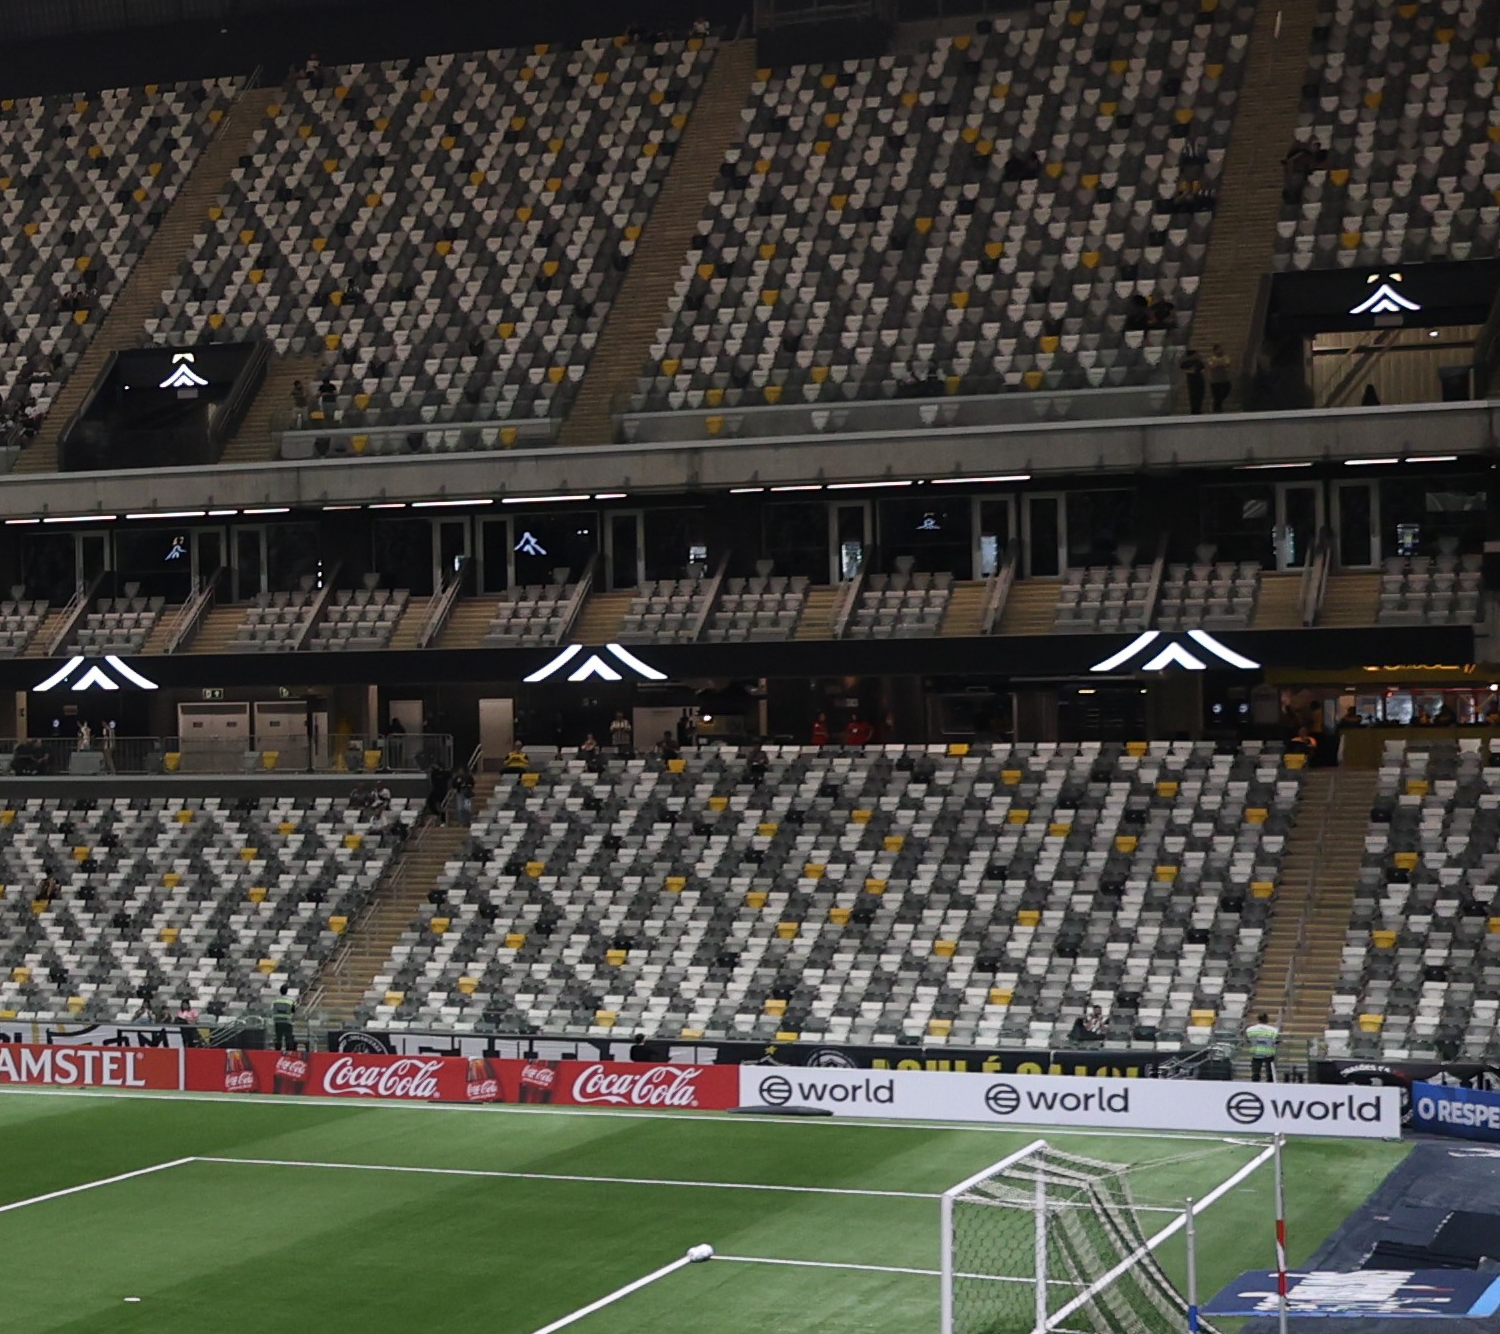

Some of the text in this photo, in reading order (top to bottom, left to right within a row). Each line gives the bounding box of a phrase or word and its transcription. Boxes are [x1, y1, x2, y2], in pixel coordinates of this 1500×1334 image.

[323, 1056, 444, 1098] Coca-Cola
[572, 1064, 702, 1106] Coca-Cola
[798, 1078, 894, 1104] world
[1026, 1087, 1129, 1113] world
[1271, 1095, 1382, 1122] world
[1418, 1097, 1435, 1120] O
